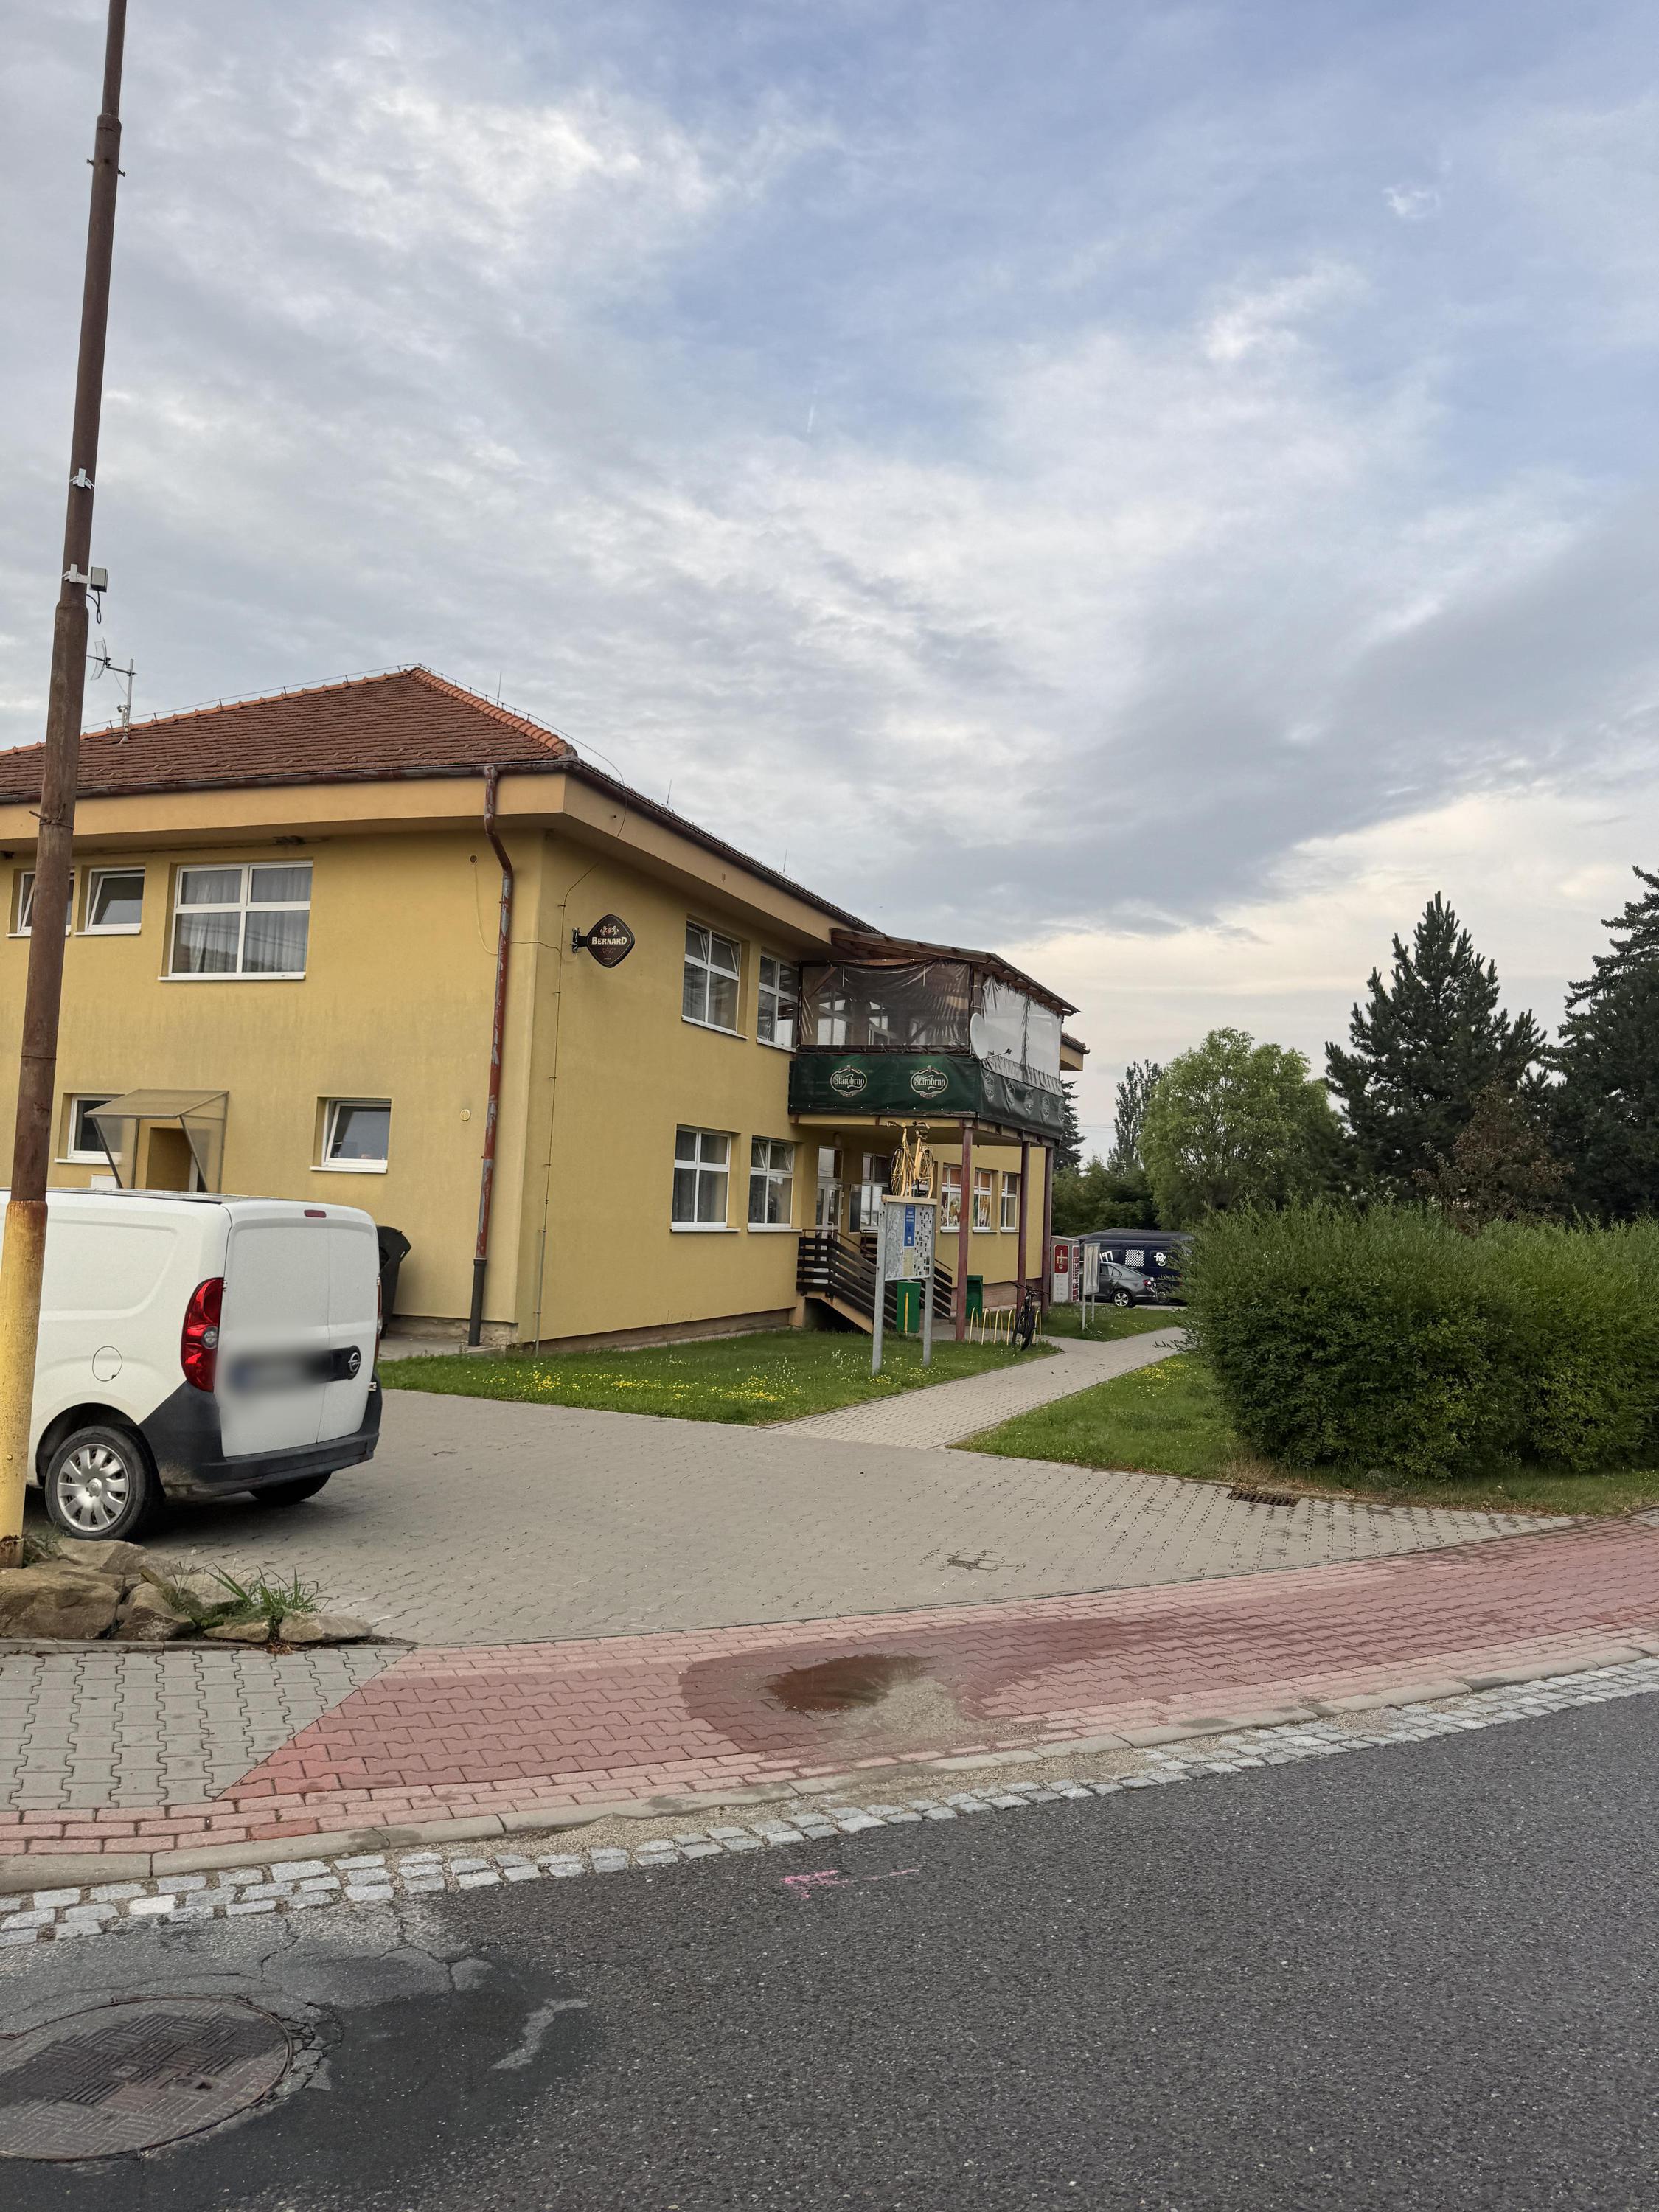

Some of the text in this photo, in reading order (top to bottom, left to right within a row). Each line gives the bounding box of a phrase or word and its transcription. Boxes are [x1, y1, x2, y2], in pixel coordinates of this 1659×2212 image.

[591, 936, 627, 945] BERNARD
[832, 1074, 865, 1088] Starobrno
[914, 1074, 946, 1089] Starobrno
